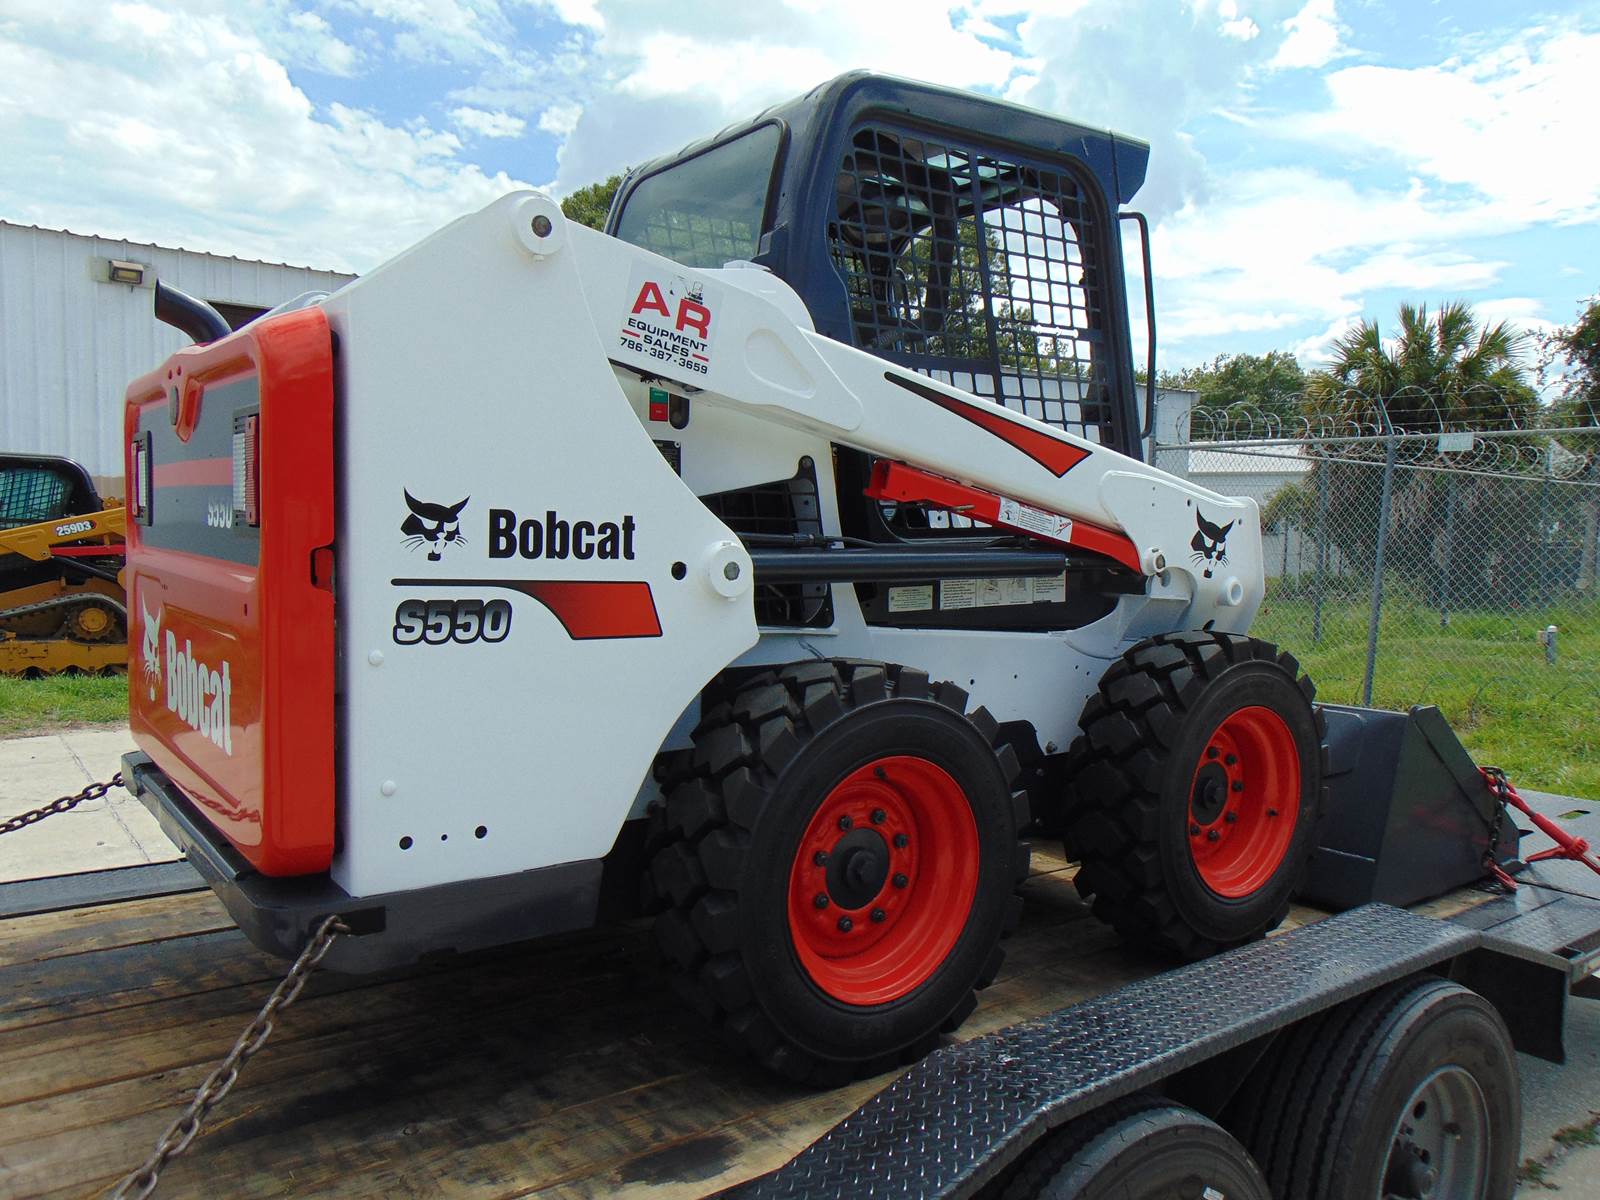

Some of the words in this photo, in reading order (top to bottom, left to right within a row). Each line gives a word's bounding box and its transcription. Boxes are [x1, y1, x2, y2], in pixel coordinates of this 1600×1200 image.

[627, 318, 708, 352] EQUIPMENT
[643, 335, 690, 357] SALES
[56, 520, 92, 536] 259D3
[489, 508, 636, 560] Bobcat
[393, 599, 513, 645] S550
[165, 628, 233, 758] Bobcat
